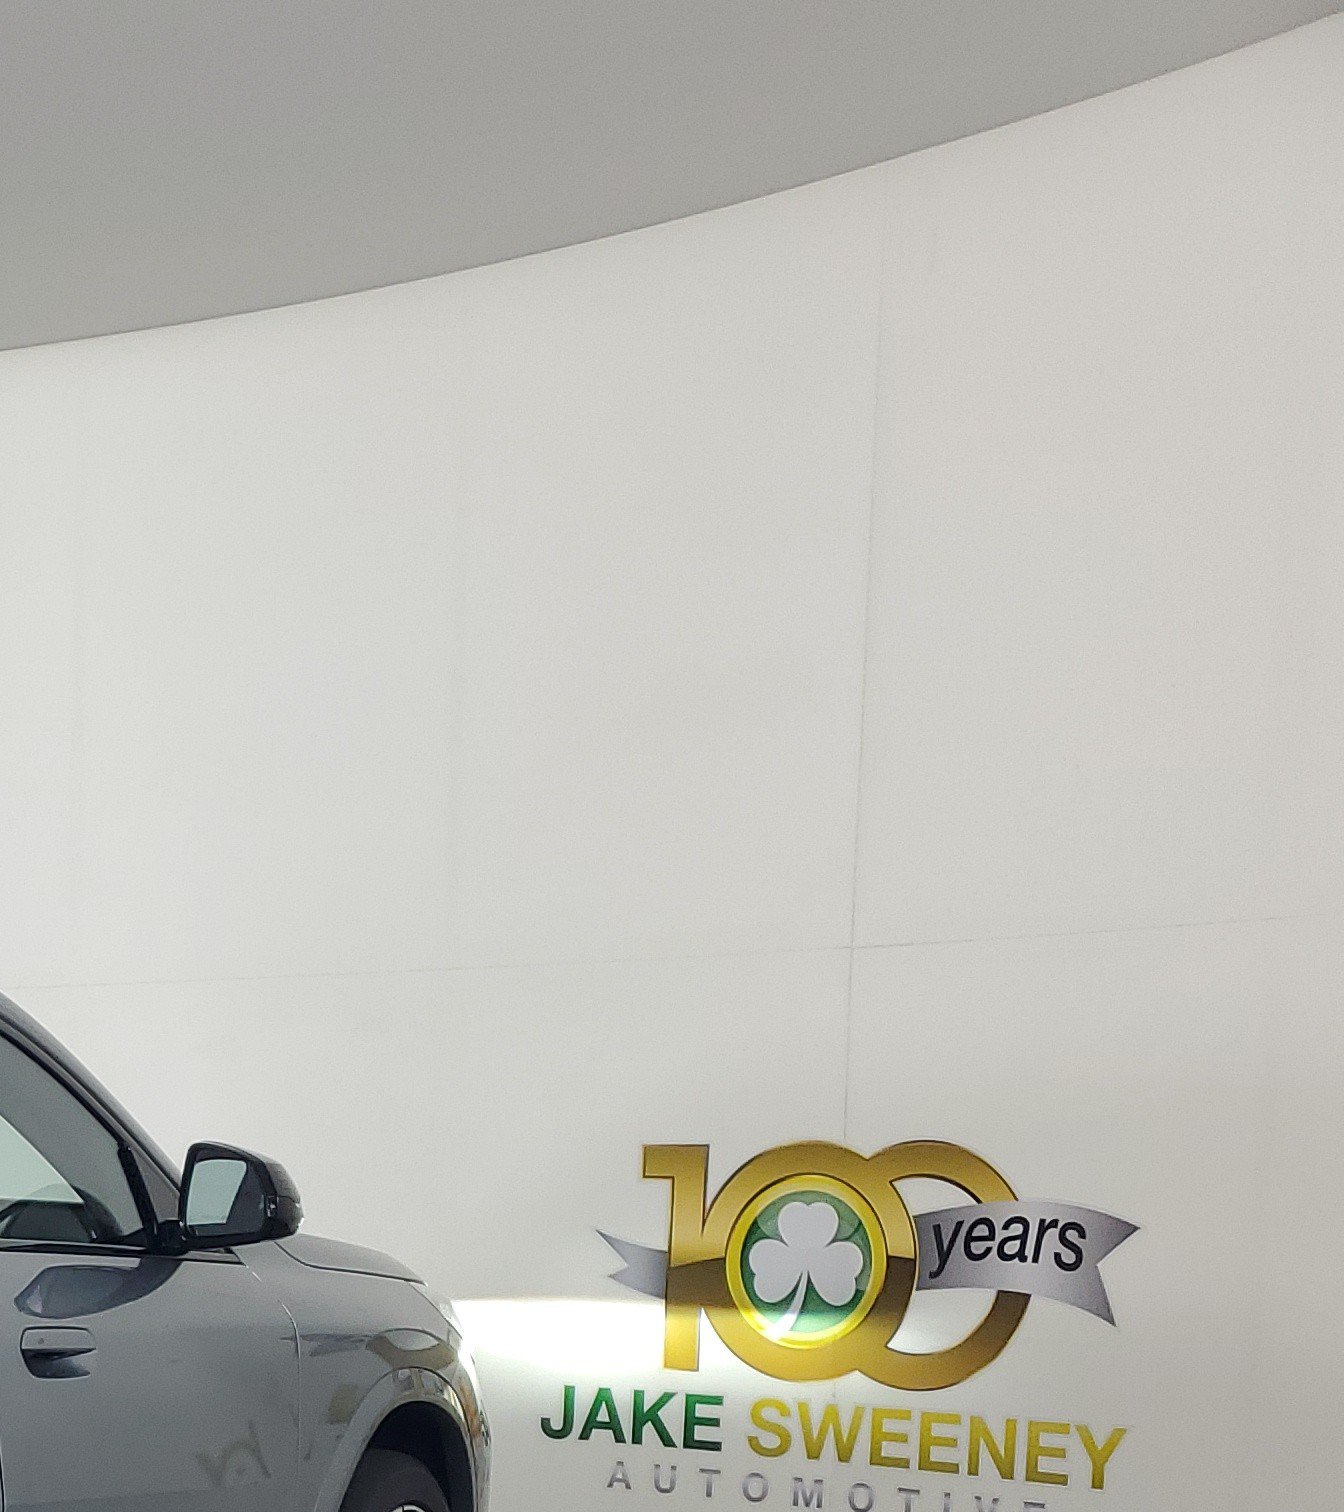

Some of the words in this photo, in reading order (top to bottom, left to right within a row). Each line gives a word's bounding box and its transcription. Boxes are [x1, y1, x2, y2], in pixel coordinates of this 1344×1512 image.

[642, 1139, 1032, 1392] 100
[926, 1212, 1088, 1280] years
[540, 1384, 725, 1453] JAKE
[747, 1398, 1128, 1492] SWEENEY
